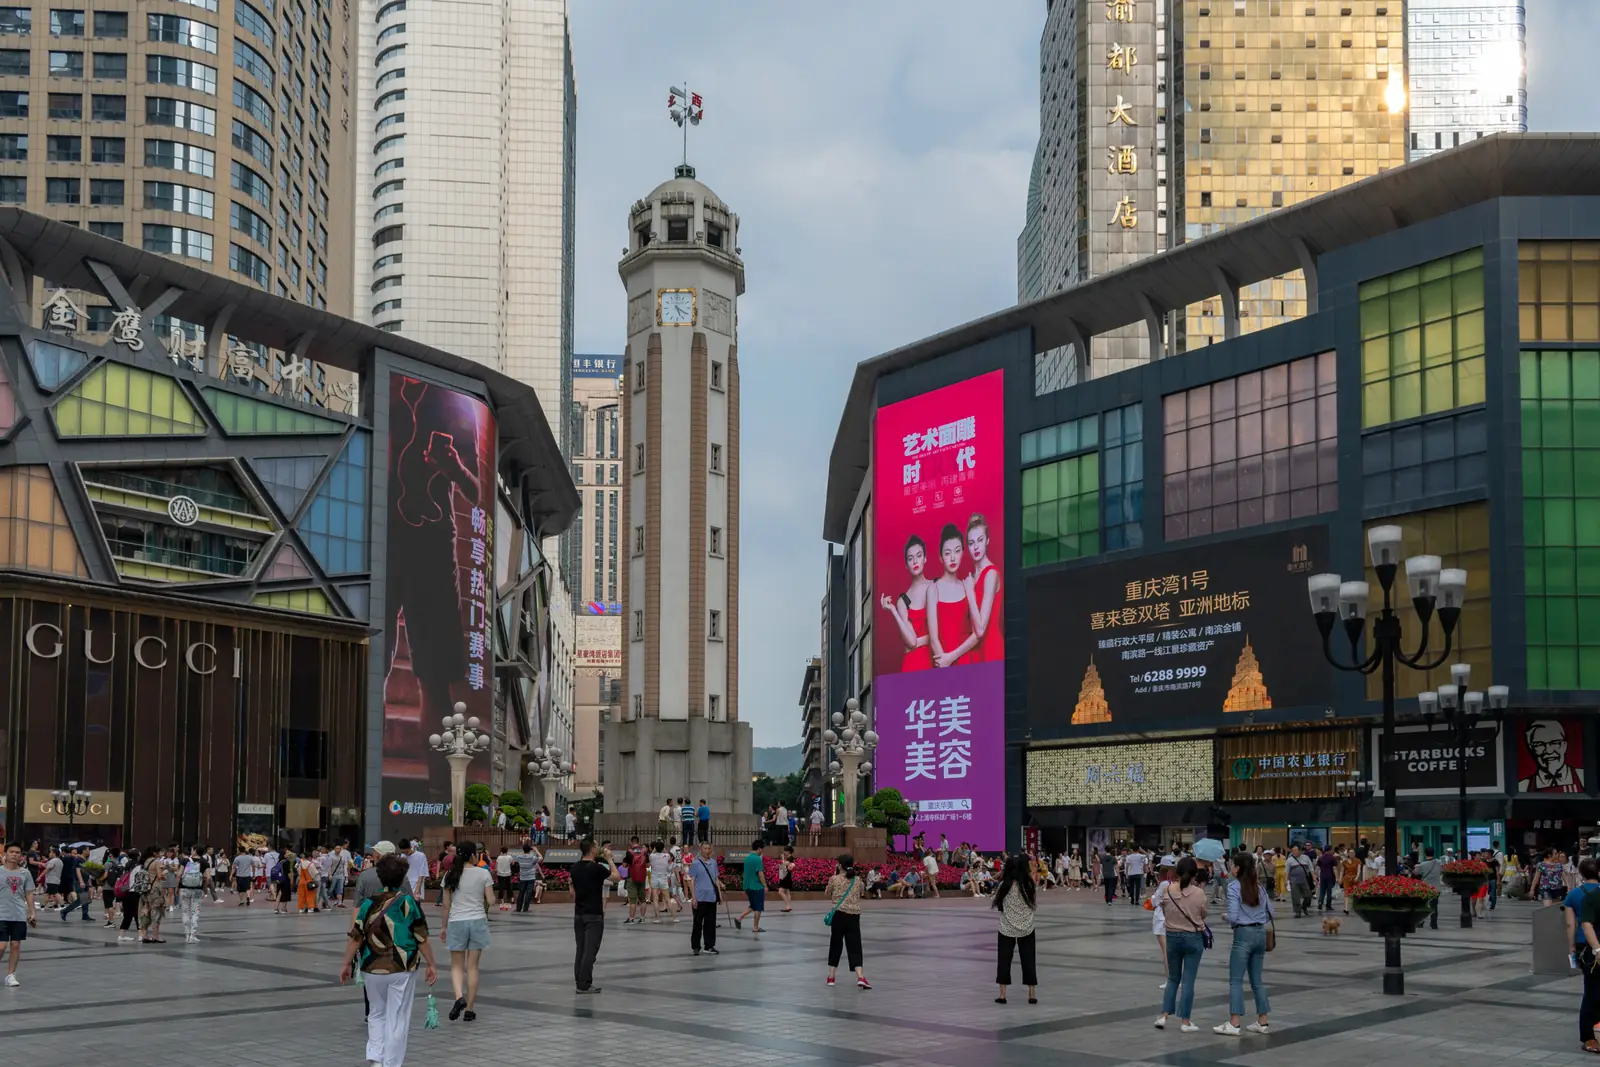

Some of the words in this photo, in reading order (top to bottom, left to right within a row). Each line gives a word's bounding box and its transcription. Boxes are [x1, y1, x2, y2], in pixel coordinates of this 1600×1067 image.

[691, 92, 703, 108] 西
[903, 416, 976, 457] 艺术面雕
[903, 460, 921, 485] 时
[956, 446, 976, 472] 代
[469, 507, 486, 690] 畅享热门赛事
[1125, 569, 1210, 602] 重庆湾1号
[1090, 602, 1171, 630] 喜来登双塔
[1179, 590, 1251, 618] 亚洲地标
[1162, 627, 1197, 641] 精装公寓
[1205, 621, 1242, 636] 南滨金铺
[26, 623, 241, 679] GUCCI
[1121, 640, 1215, 661] 南滨路一线江景珍藏资产
[1176, 665, 1207, 680] 9999
[905, 695, 972, 739] 华美
[905, 738, 972, 781] 美容
[1259, 753, 1346, 770] 中国农业银行
[1085, 763, 1146, 785] 周六福
[40, 802, 110, 815] GUCCI
[402, 802, 444, 815] 腾讯新闻
